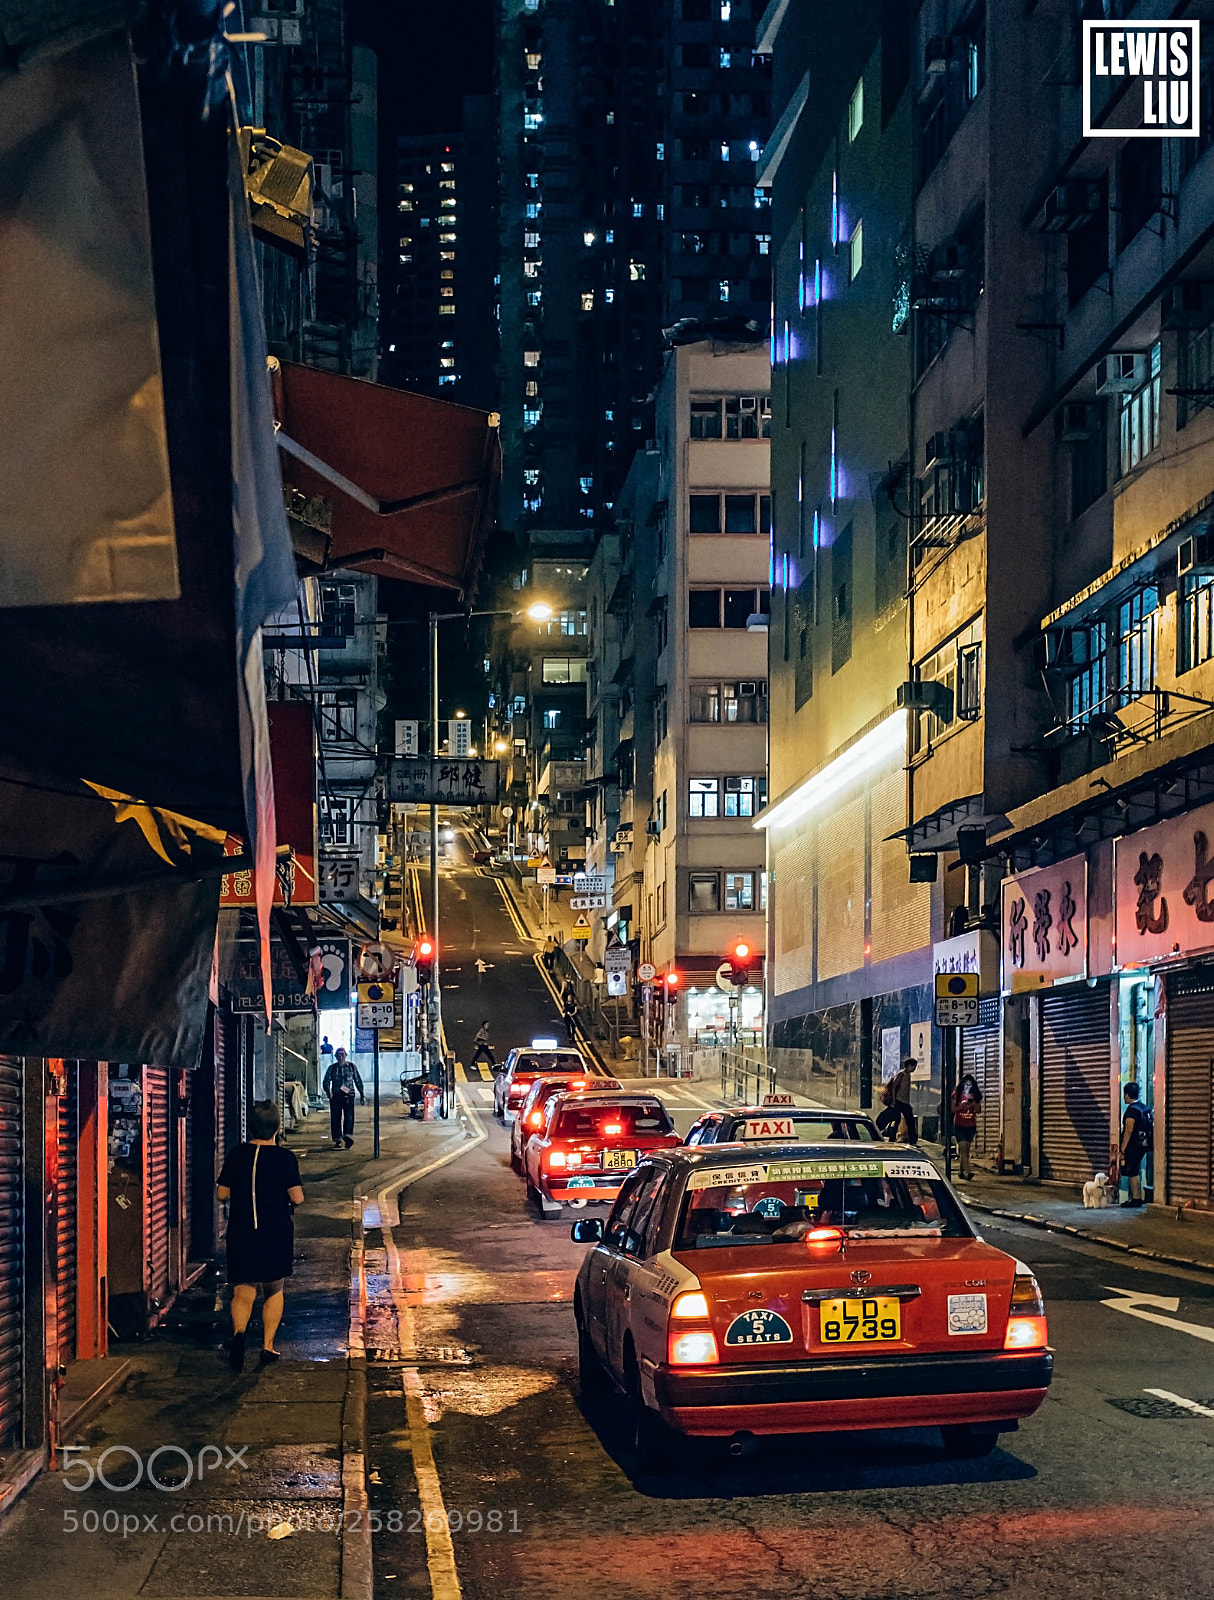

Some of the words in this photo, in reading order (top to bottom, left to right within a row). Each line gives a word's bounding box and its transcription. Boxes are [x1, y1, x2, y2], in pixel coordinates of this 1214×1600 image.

[256, 994, 285, 1007] 219
[952, 999, 977, 1010] 8-10
[372, 1005, 392, 1014] 8-10
[372, 1017, 389, 1026] 5-7
[952, 1014, 972, 1024] 5-7
[766, 1095, 792, 1104] TAXI
[749, 1120, 791, 1135] TAXI
[607, 1159, 633, 1168] 4880
[767, 1203, 775, 1212] 5
[843, 1299, 878, 1320] LD
[742, 1311, 774, 1322] TAXI
[752, 1319, 765, 1335] 5
[824, 1318, 897, 1341] 8739
[737, 1333, 781, 1343] SEATS
